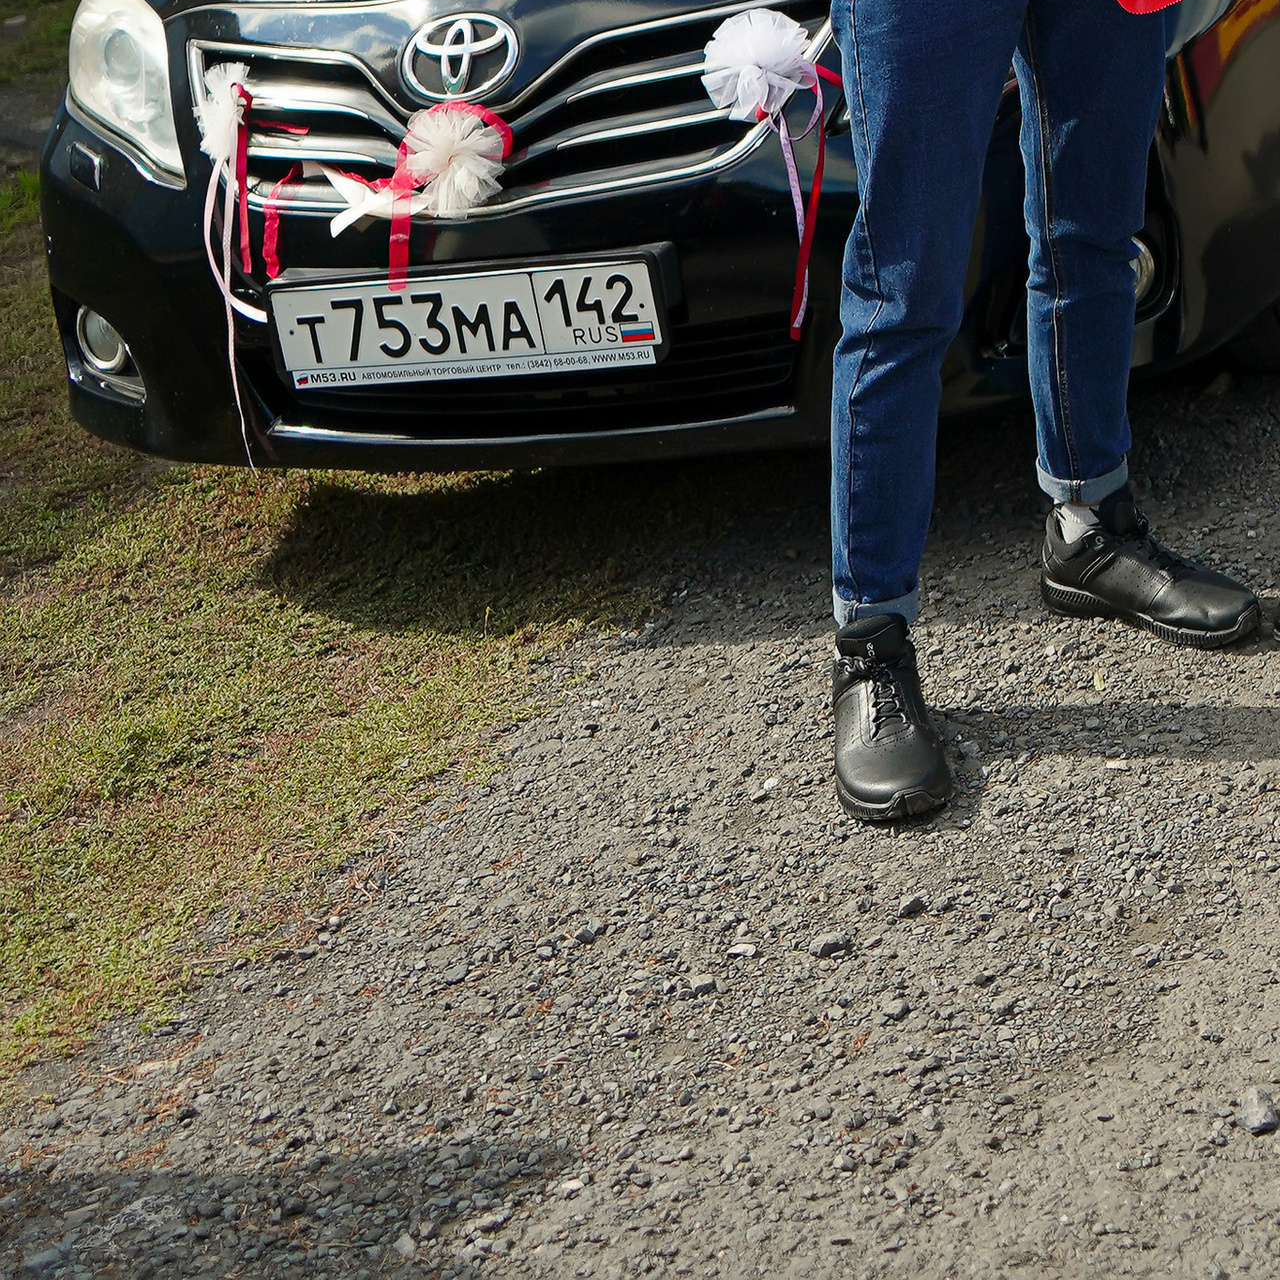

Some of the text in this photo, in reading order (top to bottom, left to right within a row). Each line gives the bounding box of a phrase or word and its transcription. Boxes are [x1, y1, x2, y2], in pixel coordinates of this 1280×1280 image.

[544, 274, 639, 327] 142
[572, 326, 619, 345] RUS
[310, 372, 357, 384] M53.RU
[361, 367, 431, 380] АВТОМОБИЛЬНЫЙ
[432, 364, 475, 376] ТОРГОВЫЙ
[477, 363, 502, 374] ЦЕНТР
[527, 358, 552, 370] (3842)
[592, 351, 650, 364] WWW.M53.RU
